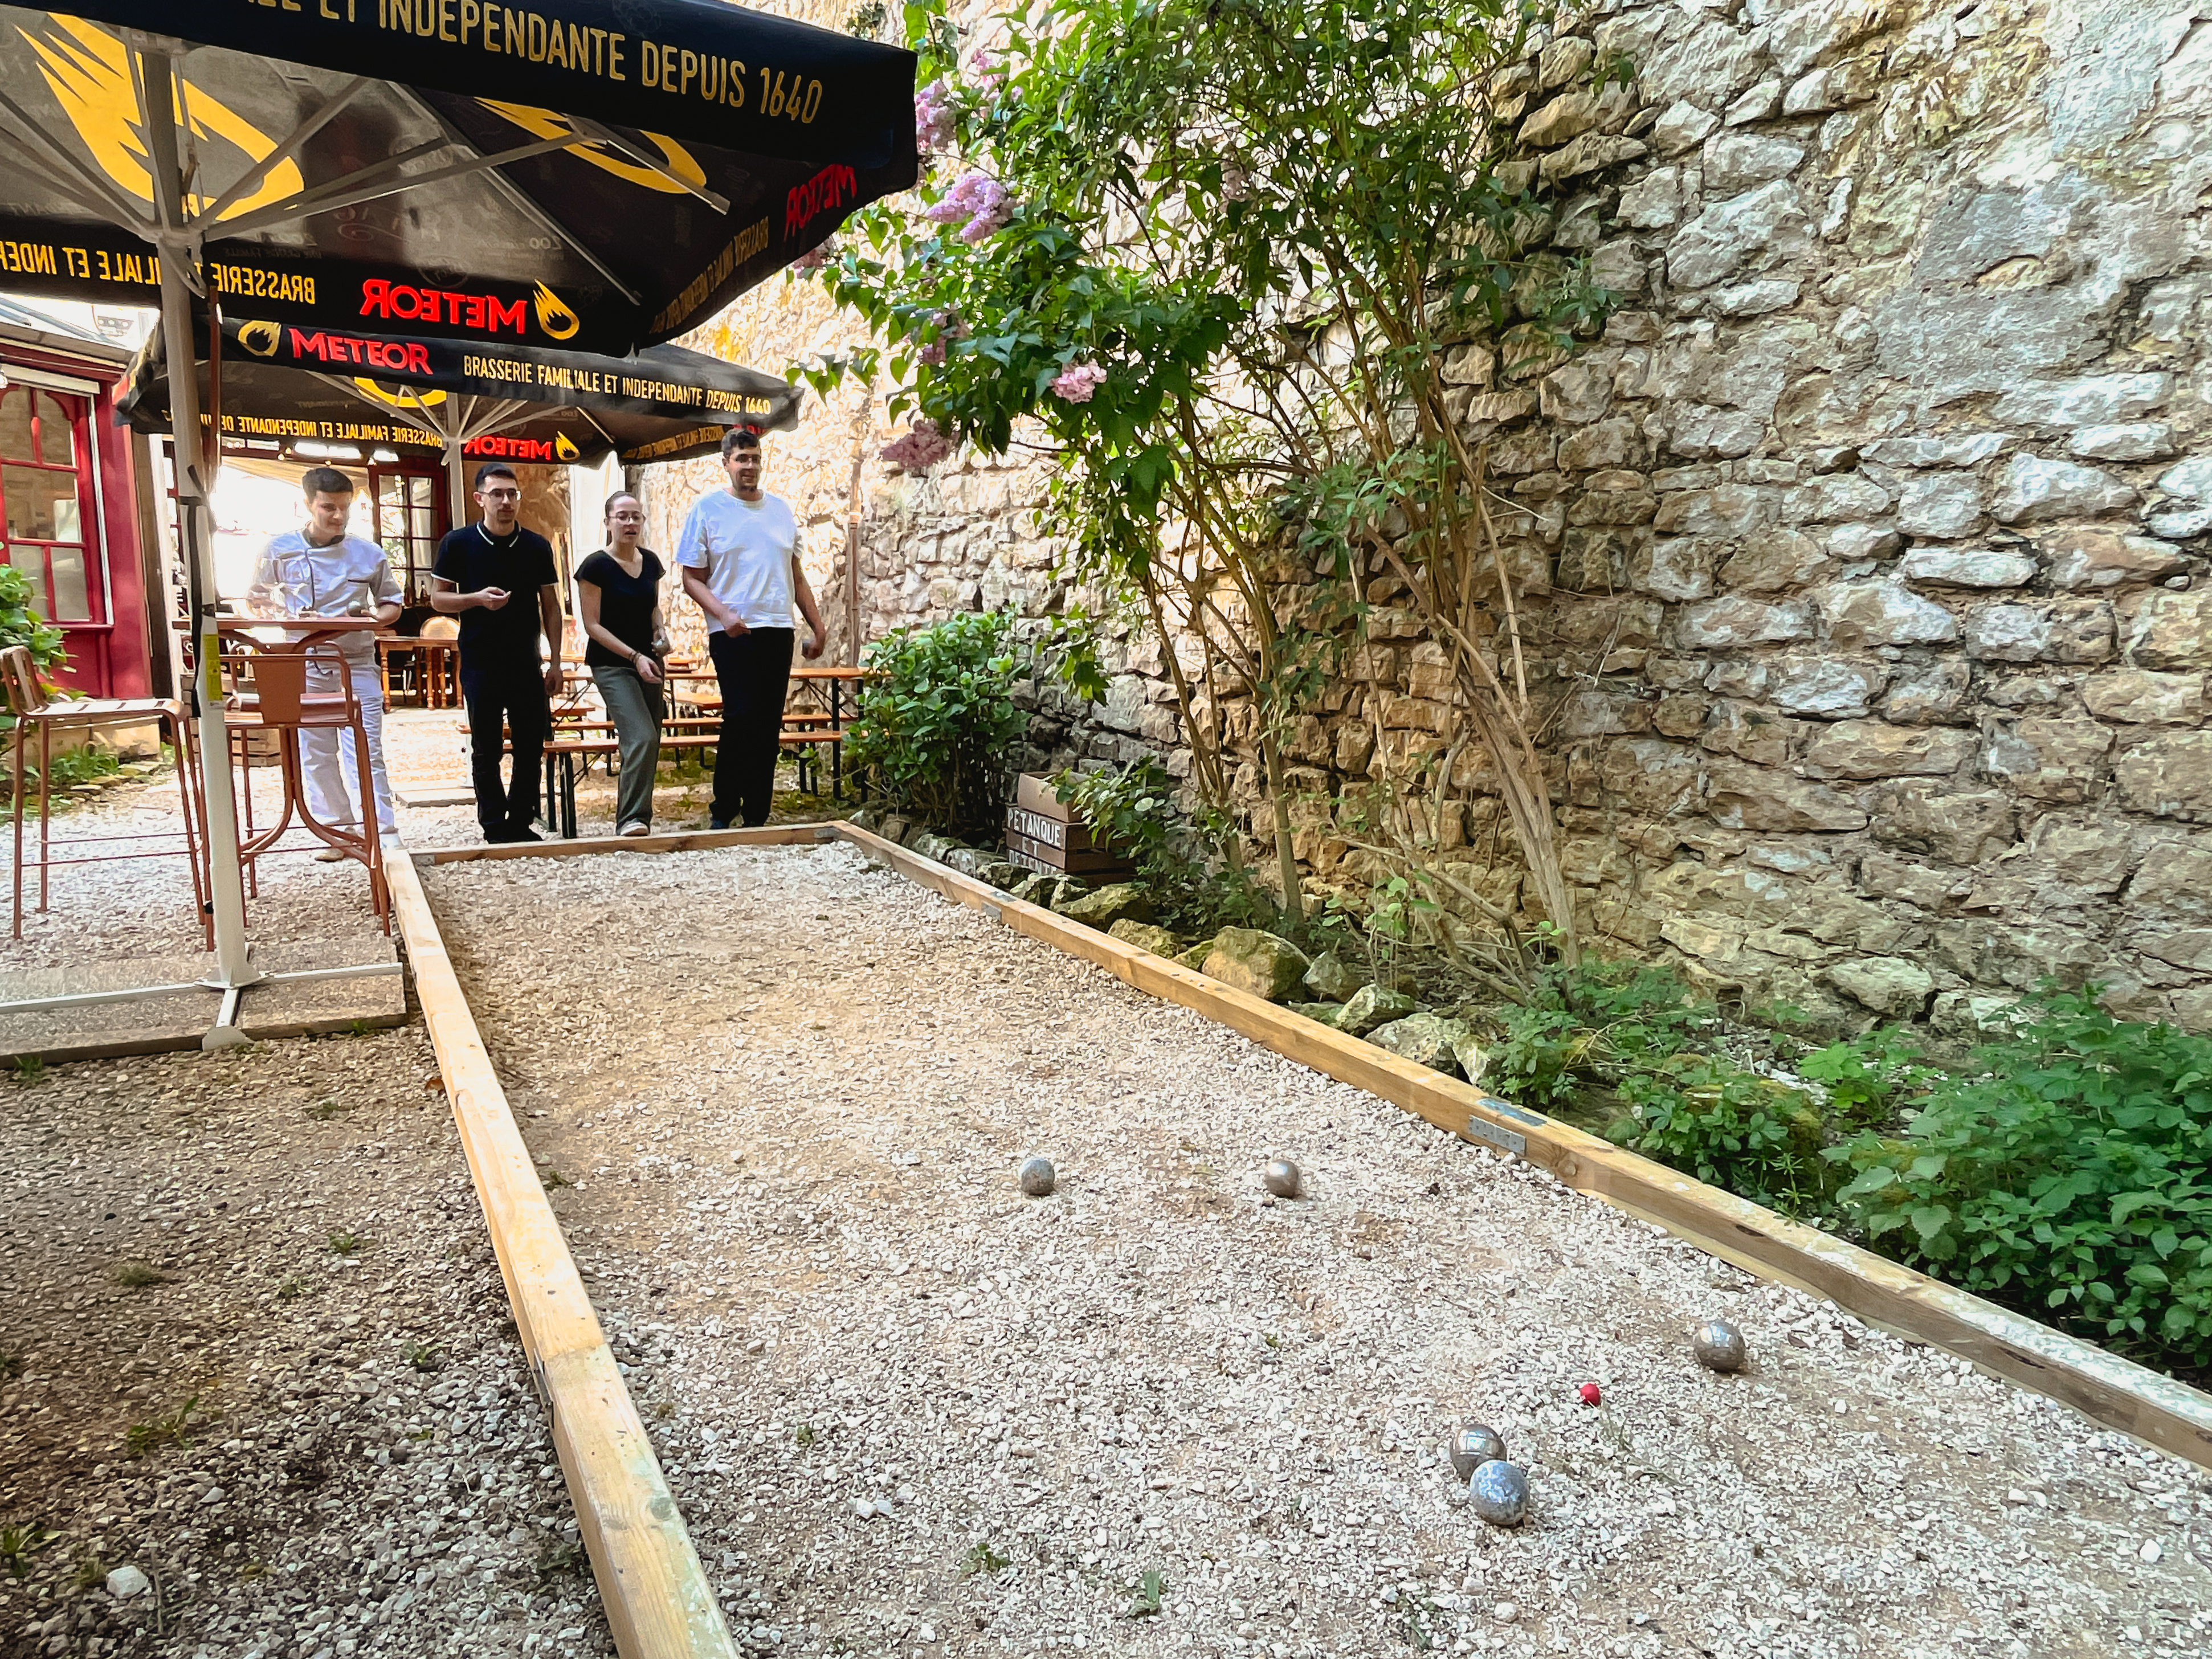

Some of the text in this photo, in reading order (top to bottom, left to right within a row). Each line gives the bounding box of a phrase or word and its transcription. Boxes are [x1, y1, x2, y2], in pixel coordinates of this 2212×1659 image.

[379, 0, 822, 124] INDEPENDANTE DEPUIS 1640
[288, 328, 434, 375] METEOR
[463, 354, 772, 415] BRASSERIE FAMILIALE ET INDEPENDANTE DEPUIS 1640
[1007, 808, 1061, 847] PETANQUE
[1022, 836, 1039, 858] ET
